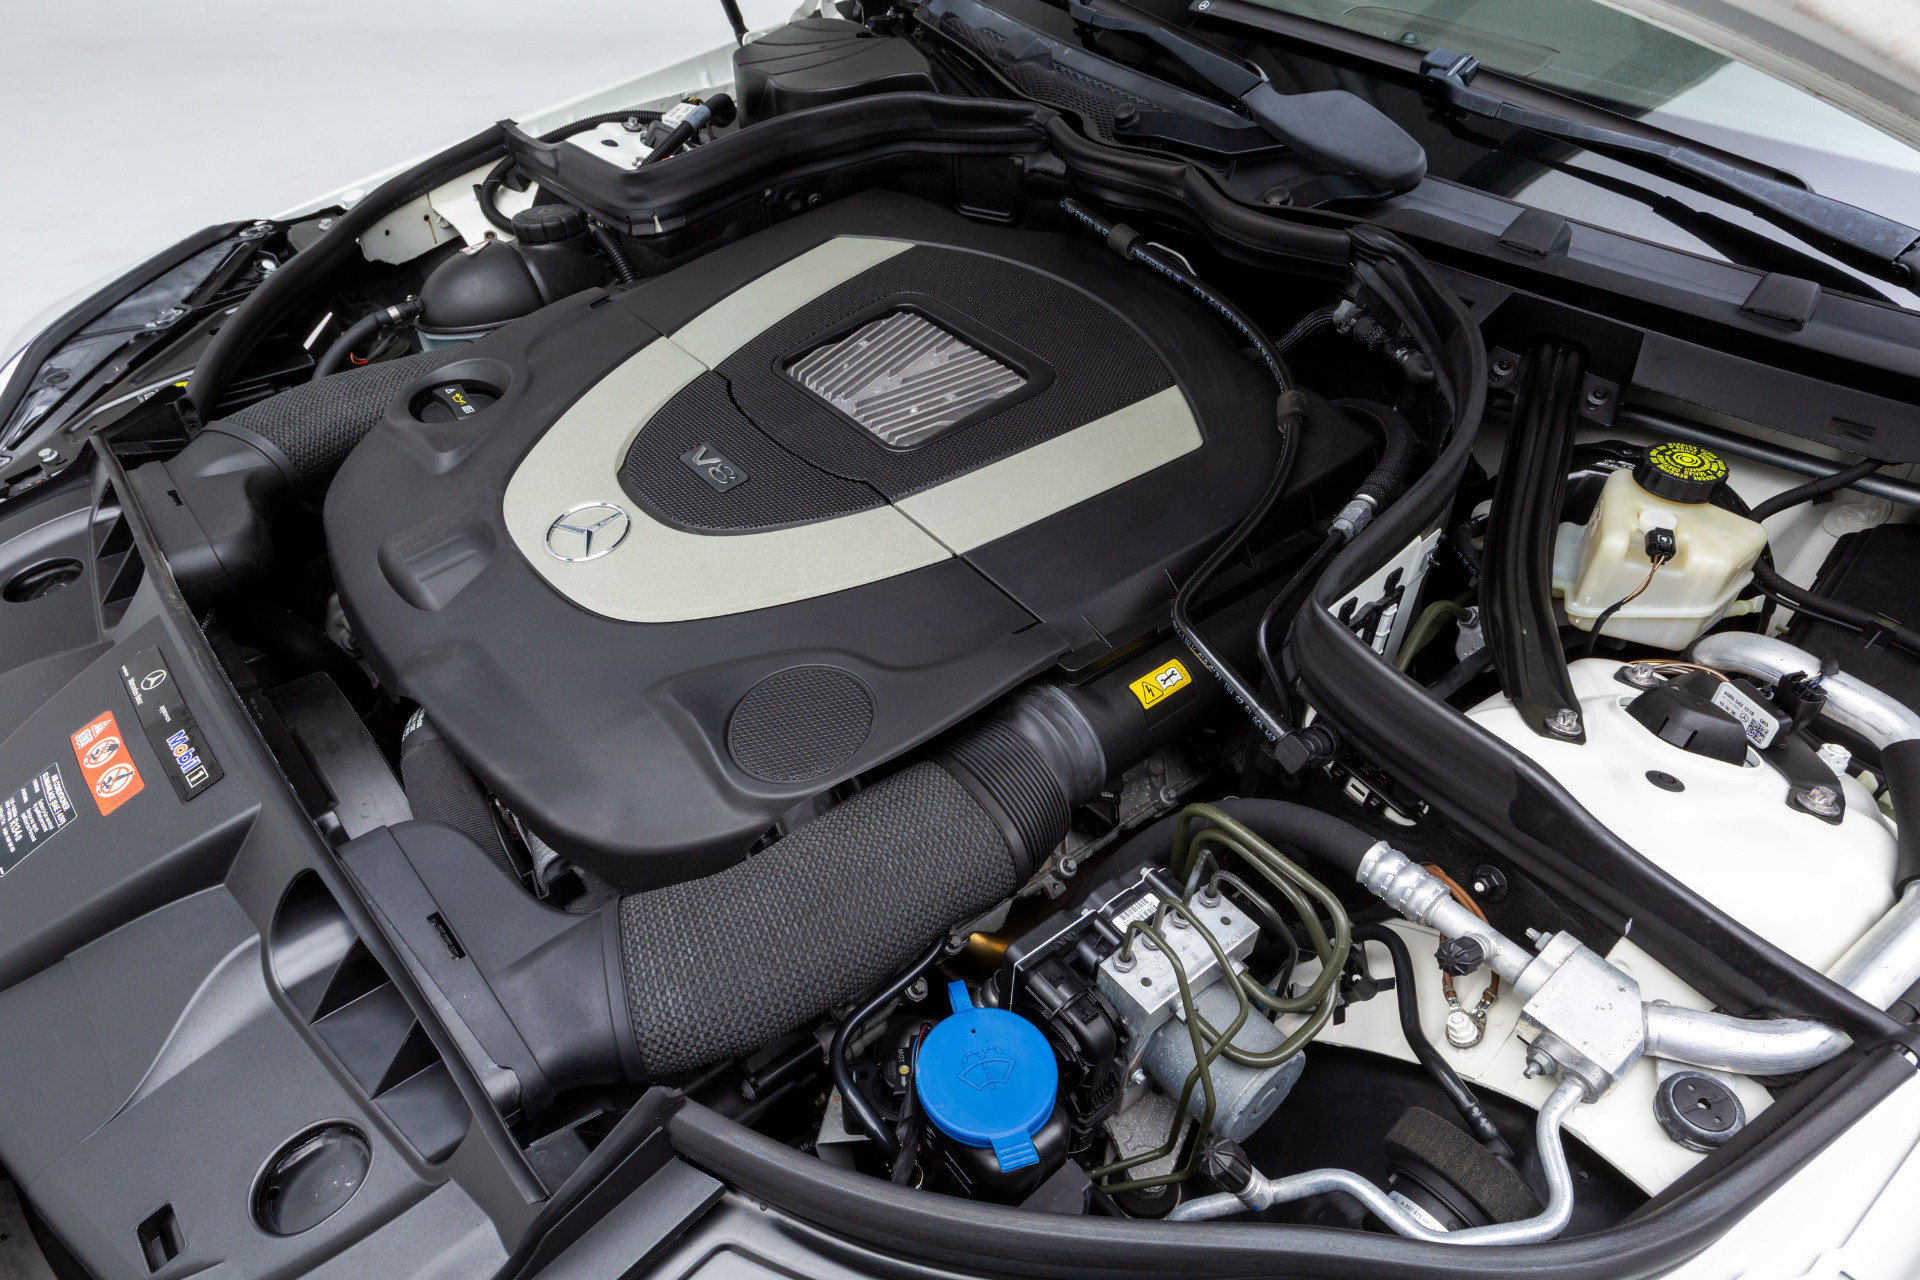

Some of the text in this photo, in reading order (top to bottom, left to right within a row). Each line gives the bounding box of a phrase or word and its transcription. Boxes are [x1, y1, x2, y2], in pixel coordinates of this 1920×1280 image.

[692, 446, 737, 484] V8
[166, 729, 201, 774] Mobil
[9, 817, 22, 842] R134a
